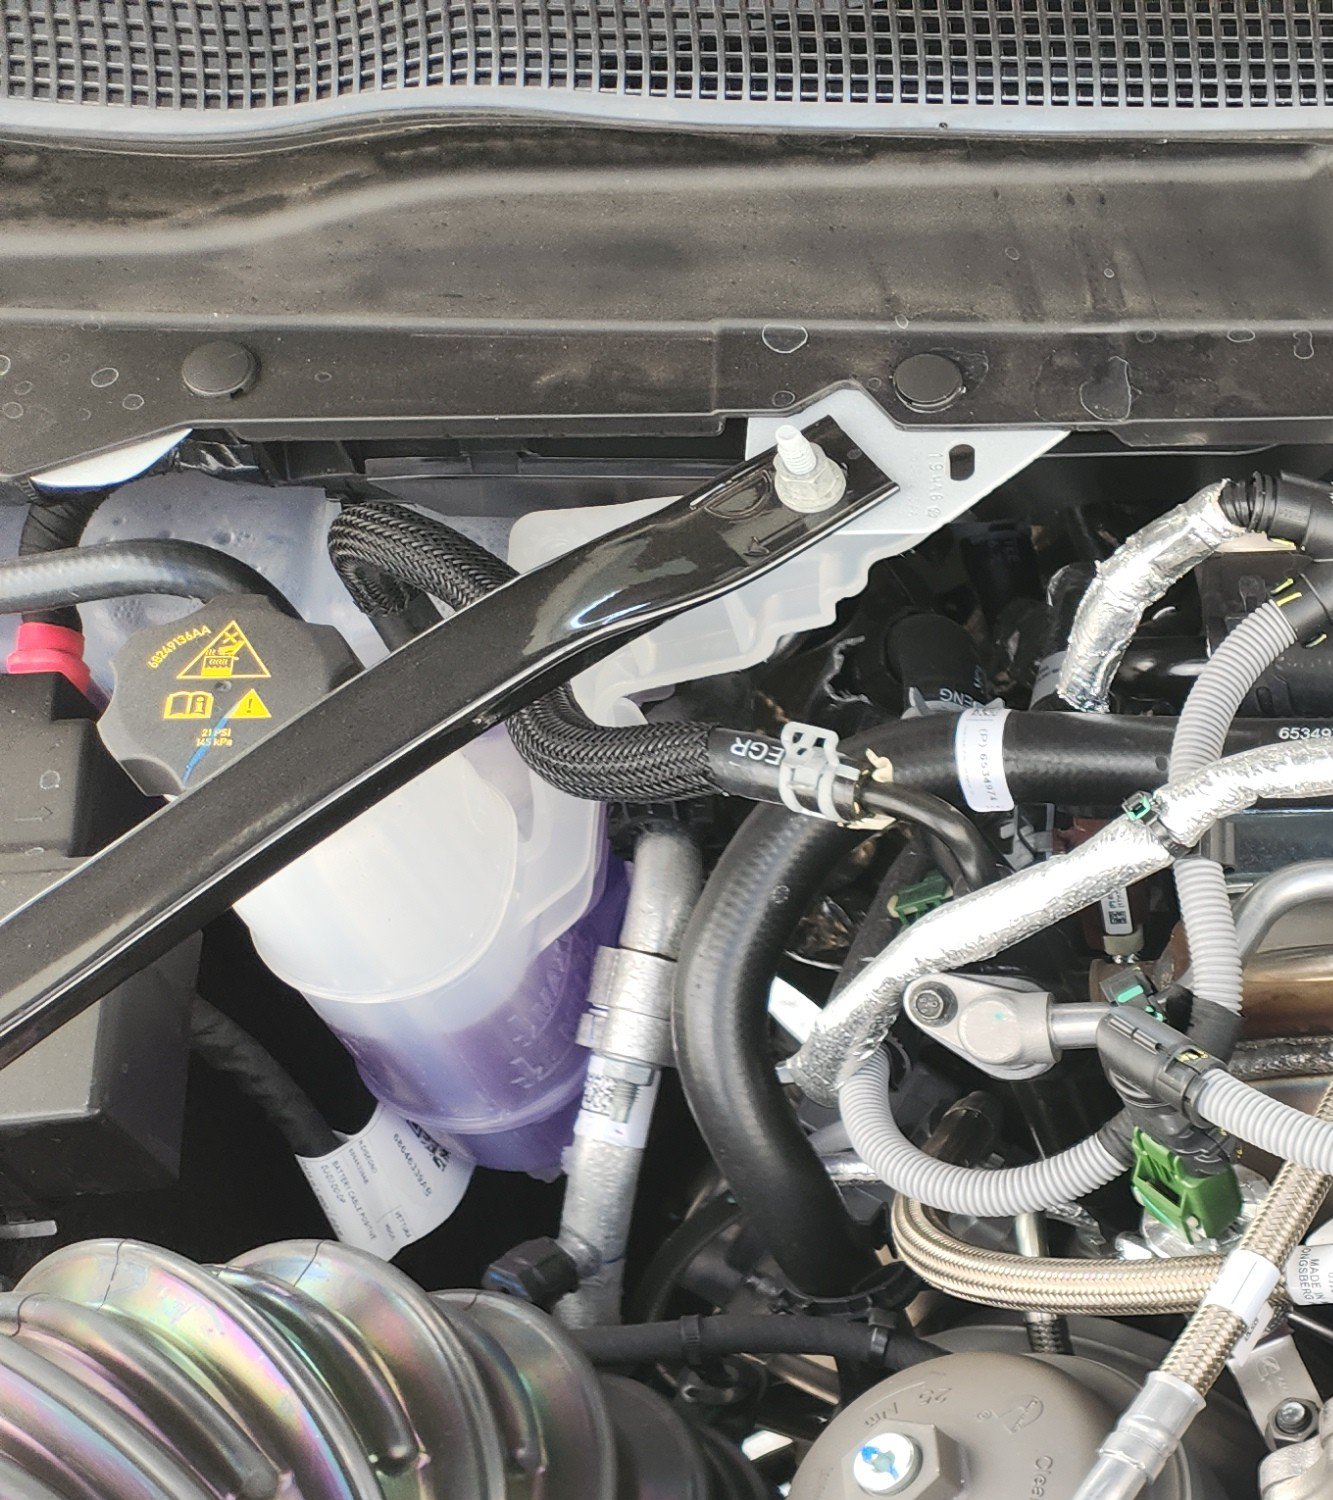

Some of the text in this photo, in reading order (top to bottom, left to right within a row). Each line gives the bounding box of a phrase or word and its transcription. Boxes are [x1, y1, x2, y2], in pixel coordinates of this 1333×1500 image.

[147, 624, 212, 670] 68249136AA
[213, 727, 232, 738] PSI
[213, 737, 233, 747] kPa
[730, 736, 785, 765] EGR
[1309, 1258, 1321, 1289] MADE
